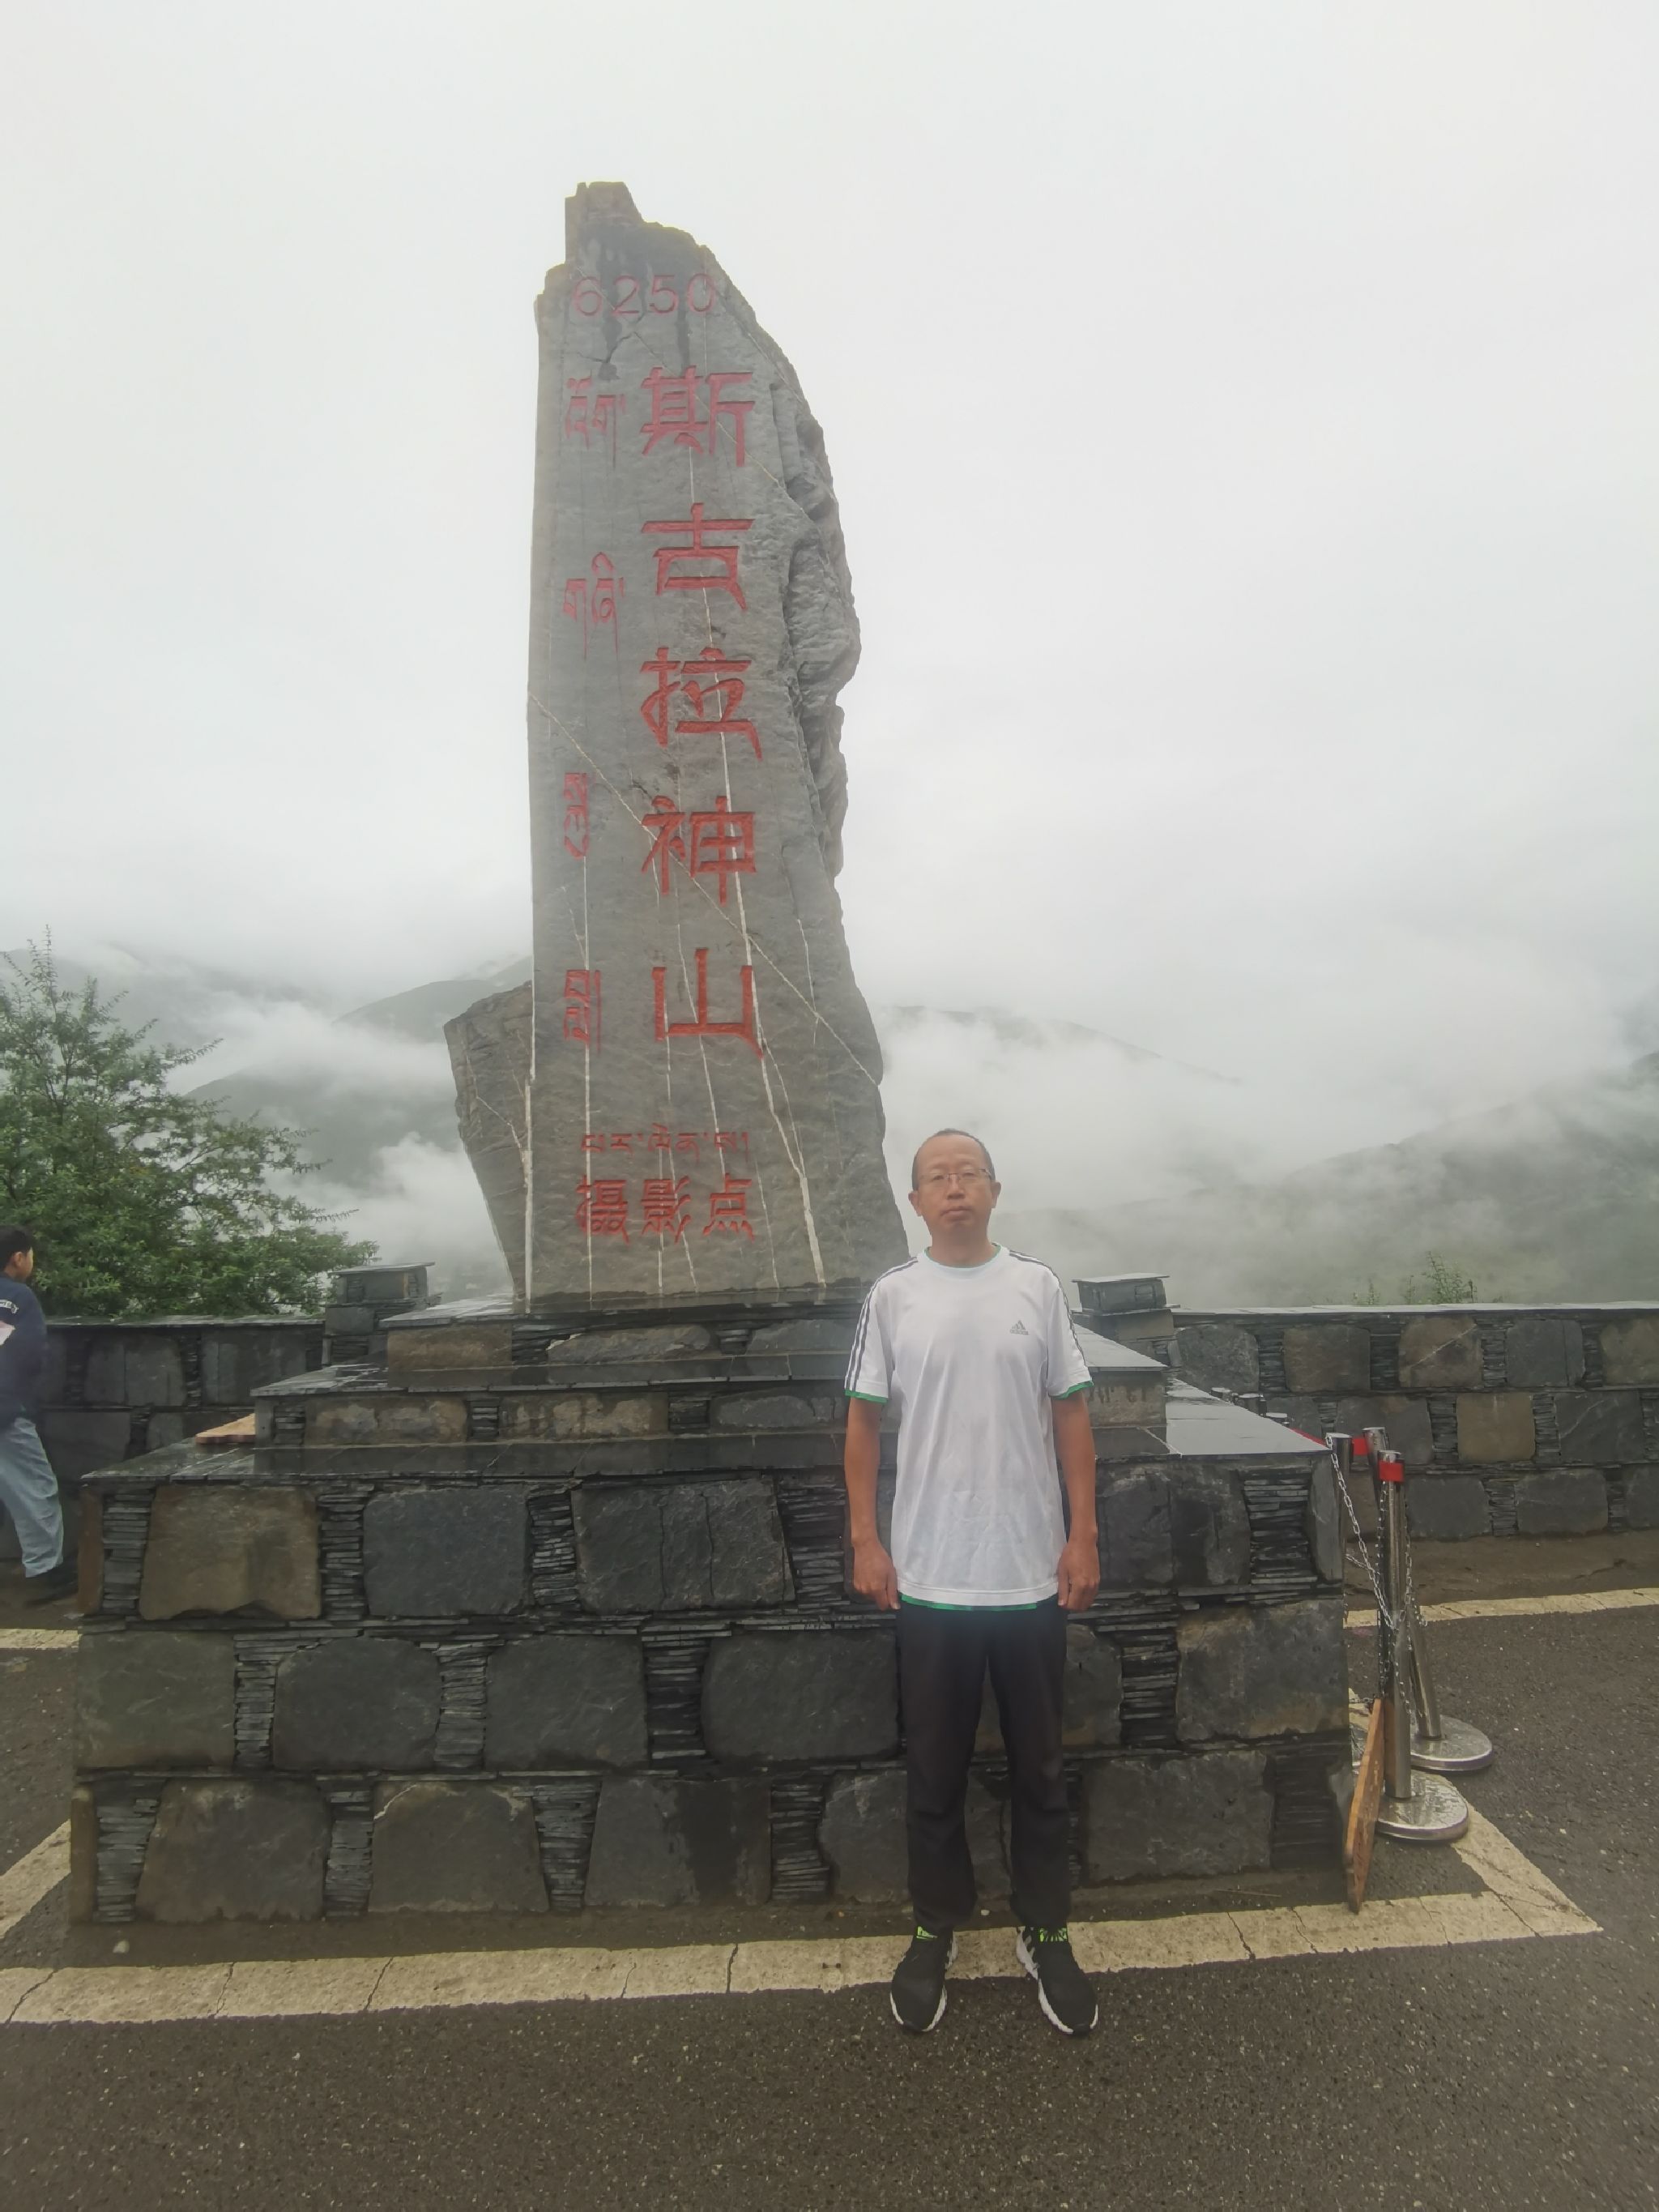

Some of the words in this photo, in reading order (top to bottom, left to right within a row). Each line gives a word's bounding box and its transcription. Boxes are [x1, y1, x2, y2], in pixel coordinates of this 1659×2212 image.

[573, 273, 716, 316] 6250
[639, 365, 765, 1062] 斯古拉神山
